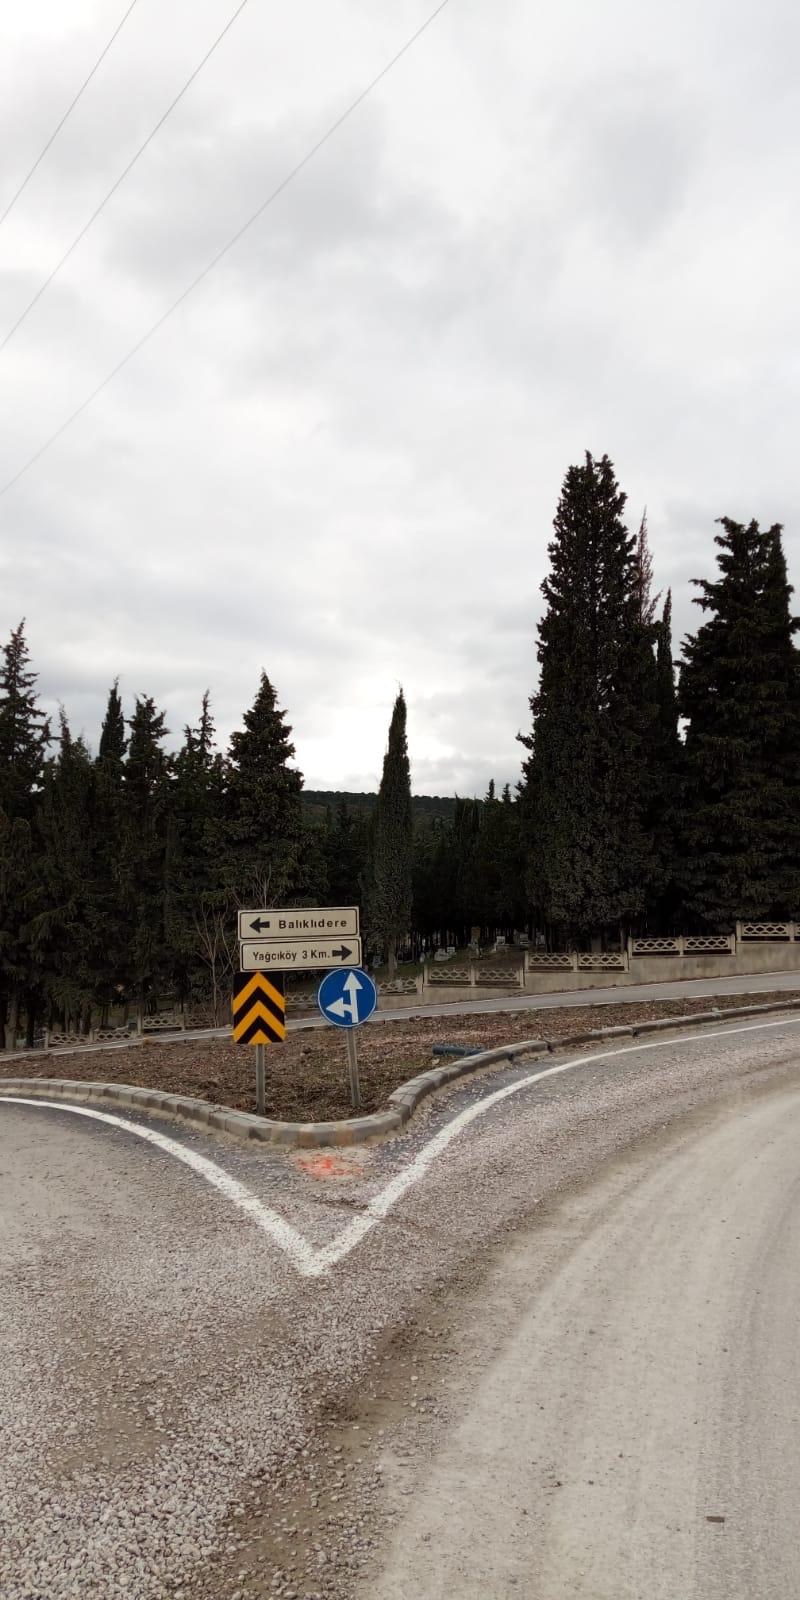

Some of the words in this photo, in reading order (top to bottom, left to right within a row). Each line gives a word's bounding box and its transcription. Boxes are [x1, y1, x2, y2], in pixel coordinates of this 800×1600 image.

[278, 918, 348, 929] Balıklıdere
[252, 950, 297, 962] Yağcıköy
[302, 950, 308, 960] 3
[311, 949, 330, 959] Km.
